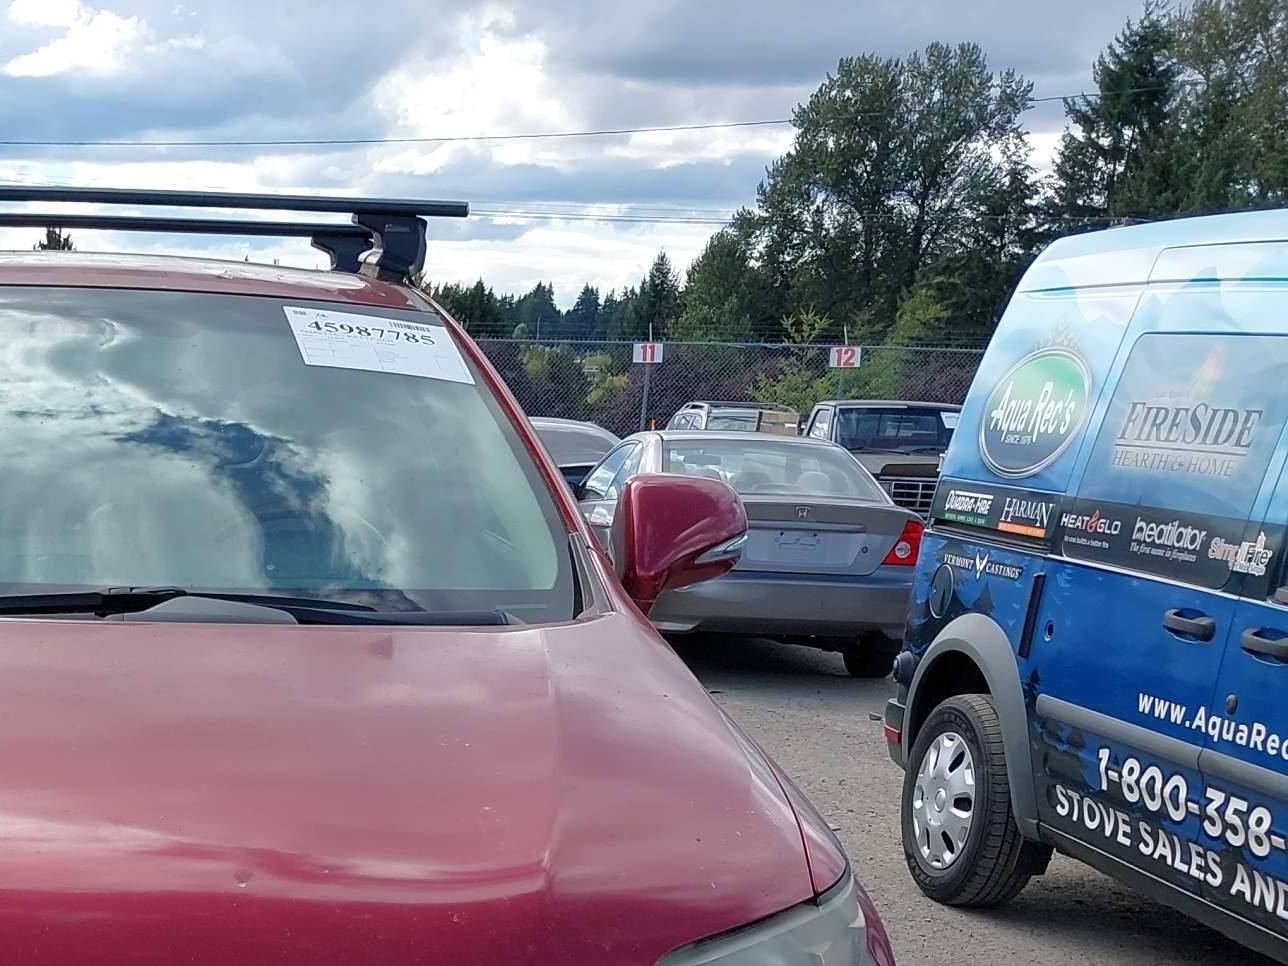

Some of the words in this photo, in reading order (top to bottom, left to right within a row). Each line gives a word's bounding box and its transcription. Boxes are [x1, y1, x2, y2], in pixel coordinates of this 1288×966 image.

[308, 320, 436, 346] 45987785
[640, 344, 656, 361] 11
[835, 348, 855, 366] 12
[990, 381, 1032, 442] Aqua
[1028, 381, 1075, 442] Rec's
[1113, 450, 1170, 472] HEARTH
[1171, 455, 1184, 472] &
[1186, 458, 1235, 477] HOME
[1000, 498, 1055, 528] HARMAN
[1132, 516, 1207, 551] heatilator
[944, 554, 974, 570] VERMONT
[1055, 784, 1132, 847] STOVE
[1138, 821, 1223, 887] SALES
[1230, 862, 1288, 923] AND
